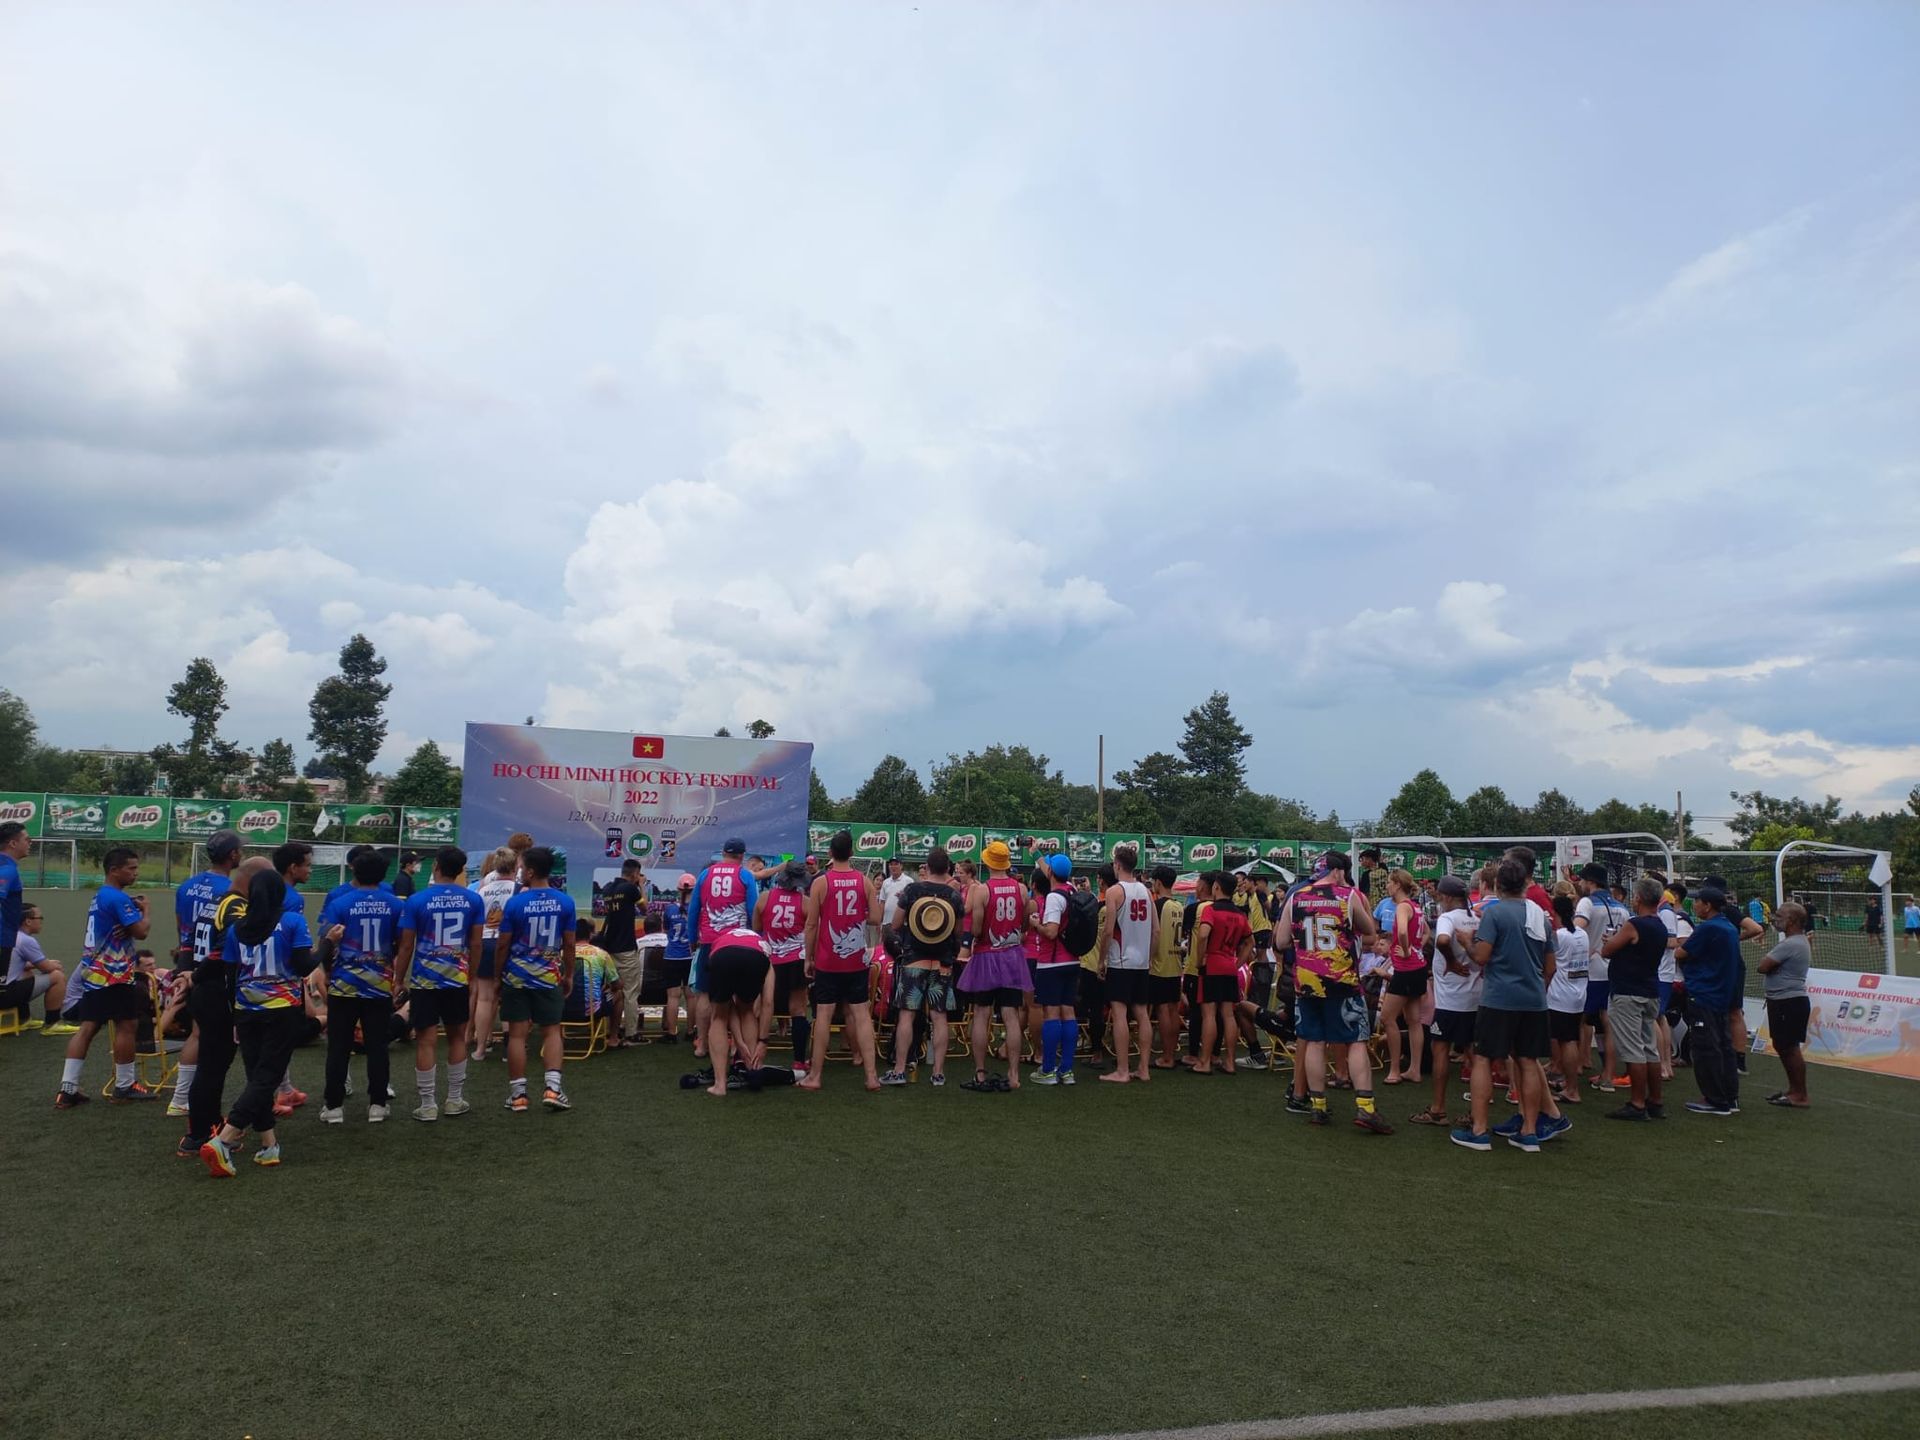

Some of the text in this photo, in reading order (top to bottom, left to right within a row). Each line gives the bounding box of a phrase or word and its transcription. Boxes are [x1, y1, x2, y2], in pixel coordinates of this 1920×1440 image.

[493, 764, 782, 790] HO CHI MINH HOCKEY FESTIVAL
[624, 790, 658, 804] 2022
[122, 811, 159, 823] MILO
[243, 816, 277, 828] MILO
[568, 811, 592, 822] 12th
[629, 814, 688, 825] November
[691, 815, 718, 826] 2022
[861, 836, 887, 847] MILO
[950, 839, 974, 849] MILO
[1192, 849, 1216, 858] MILO
[1573, 845, 1580, 857] 1
[712, 876, 732, 897] 69
[426, 901, 471, 910] MALAYSIA
[524, 905, 562, 913] MALAYSIA
[836, 890, 857, 915] 12
[996, 896, 1016, 921] 88
[1130, 899, 1147, 922] 95
[350, 907, 391, 916] MALAYSIA
[771, 905, 795, 928] 25
[360, 918, 381, 952] 11
[432, 911, 464, 946] 12
[528, 915, 557, 947] 14
[1303, 916, 1338, 951] 15
[1822, 987, 1845, 996] MINH
[1845, 990, 1877, 1000] HOCKEY
[1877, 993, 1914, 1004] FESTIVAL
